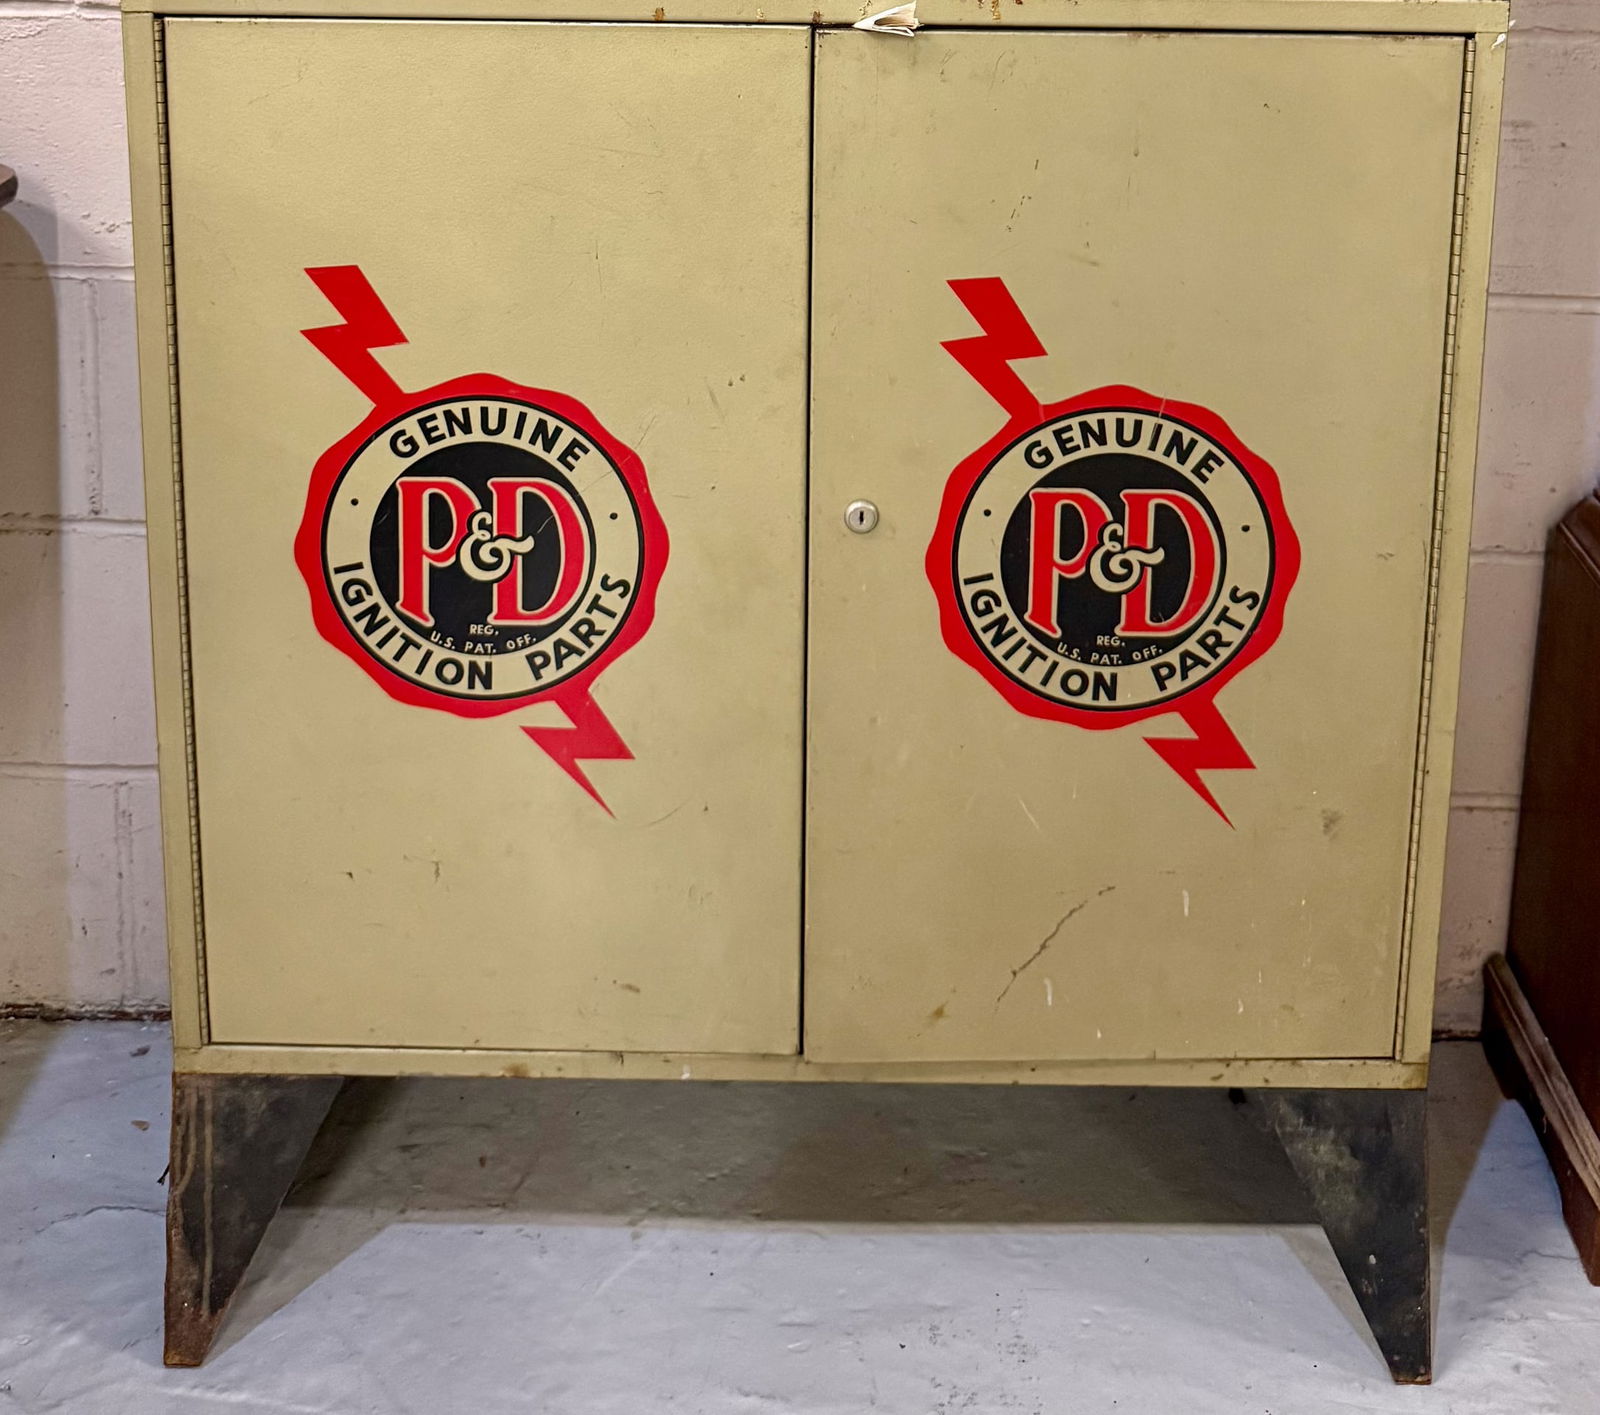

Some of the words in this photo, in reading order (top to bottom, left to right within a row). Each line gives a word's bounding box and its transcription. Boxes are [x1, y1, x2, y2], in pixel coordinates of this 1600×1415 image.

[390, 406, 589, 472] GENUINE
[1024, 417, 1225, 484] GENUINE
[396, 476, 592, 627] P&D
[1024, 487, 1222, 638] P&D
[333, 562, 493, 690] IGNITION
[525, 573, 630, 681] PARTS
[430, 630, 456, 650] U.S.
[464, 640, 496, 654] PAT.
[506, 634, 537, 651] OFF.
[470, 624, 499, 636] REG.
[963, 573, 1117, 701] IGNITION
[1150, 585, 1259, 692] PARTS
[1057, 642, 1081, 661] U.S.
[1090, 652, 1122, 664] PAT.
[1132, 645, 1163, 662] OFF.
[1096, 635, 1125, 647] REG.
